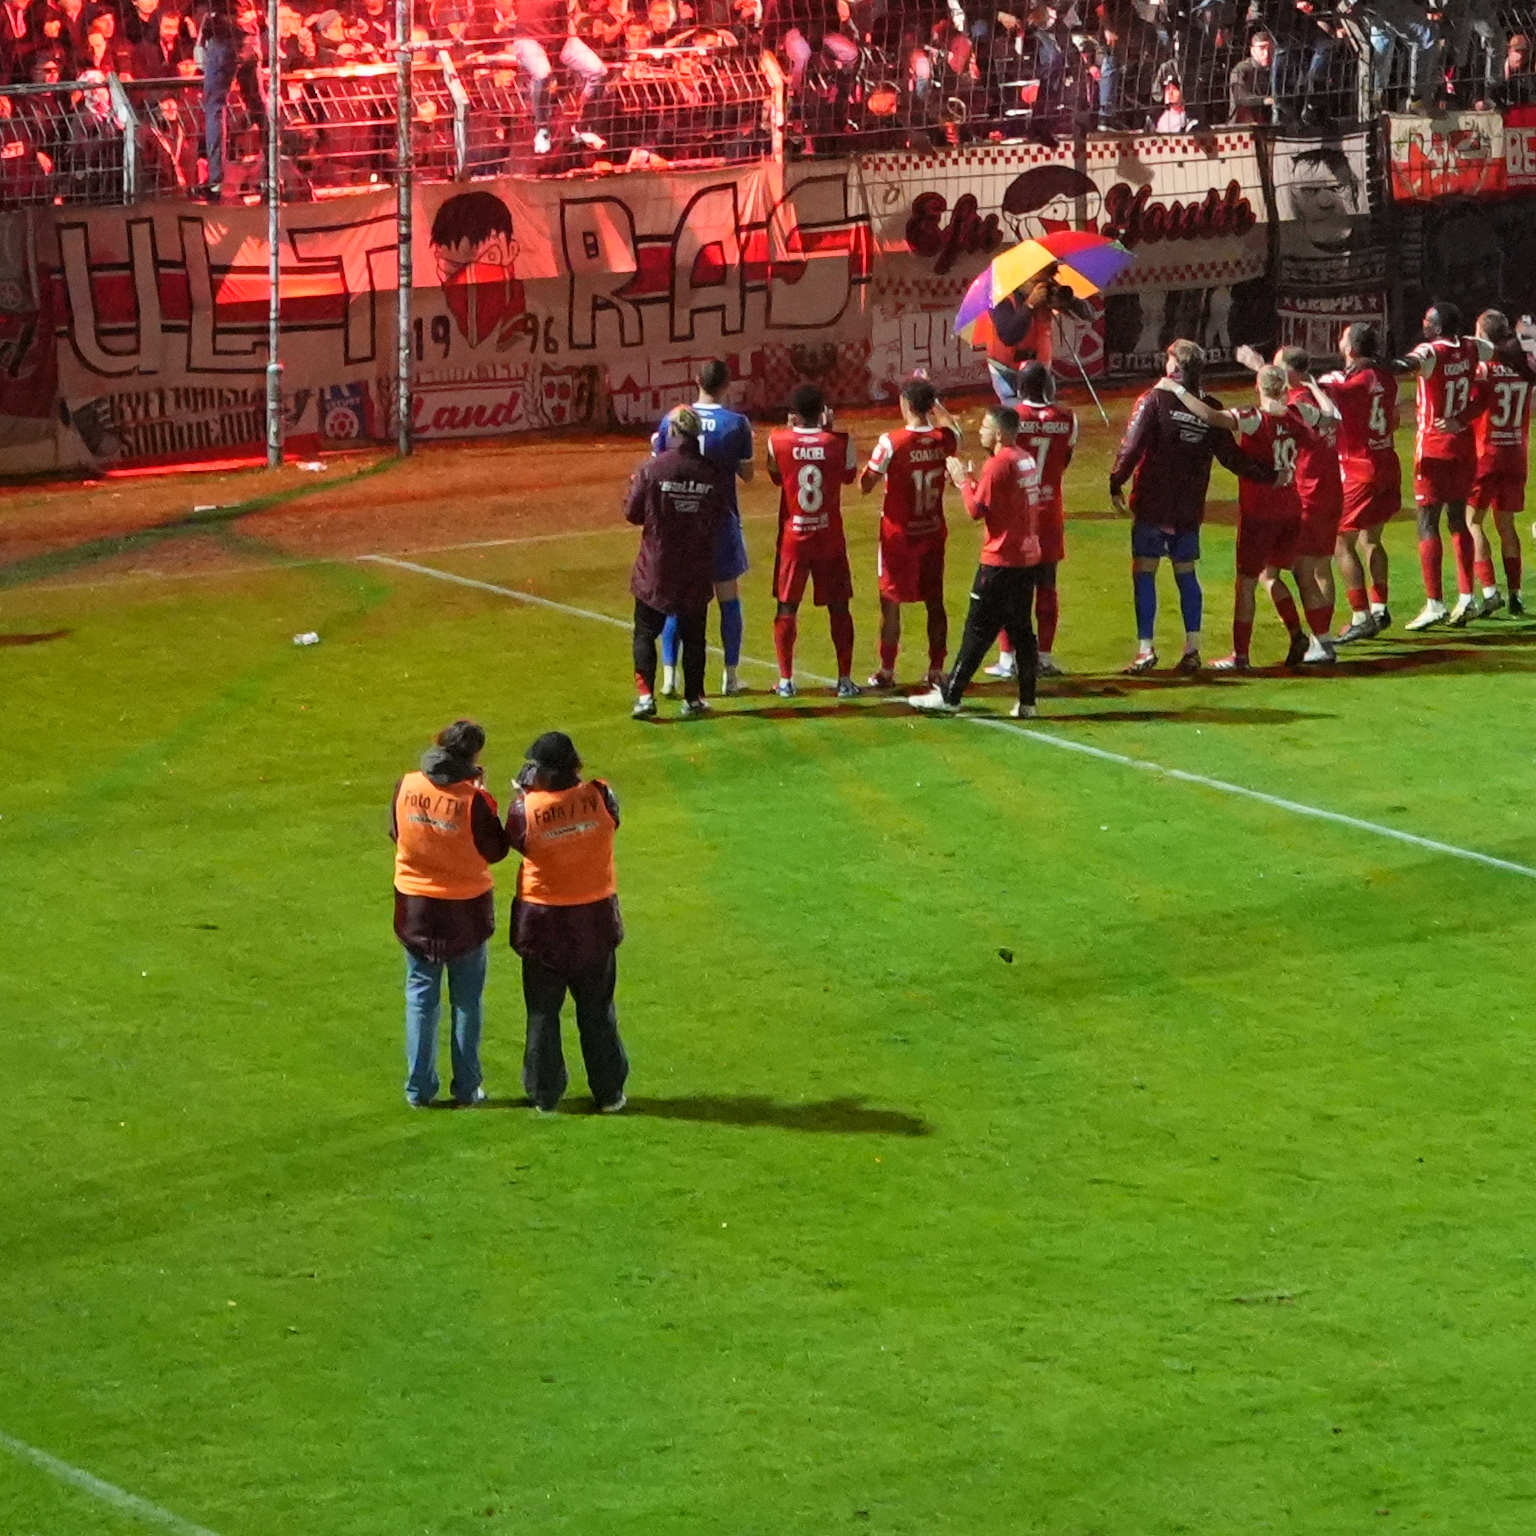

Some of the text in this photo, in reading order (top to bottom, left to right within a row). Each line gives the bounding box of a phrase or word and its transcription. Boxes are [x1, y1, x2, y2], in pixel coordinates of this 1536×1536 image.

[412, 390, 524, 434] Land
[1490, 380, 1530, 428] 37
[1029, 436, 1052, 485] 7
[797, 463, 824, 514] 8
[910, 466, 947, 516] 16
[404, 790, 431, 810] Foto
[533, 805, 563, 827] Foto
[581, 794, 599, 814] TV
